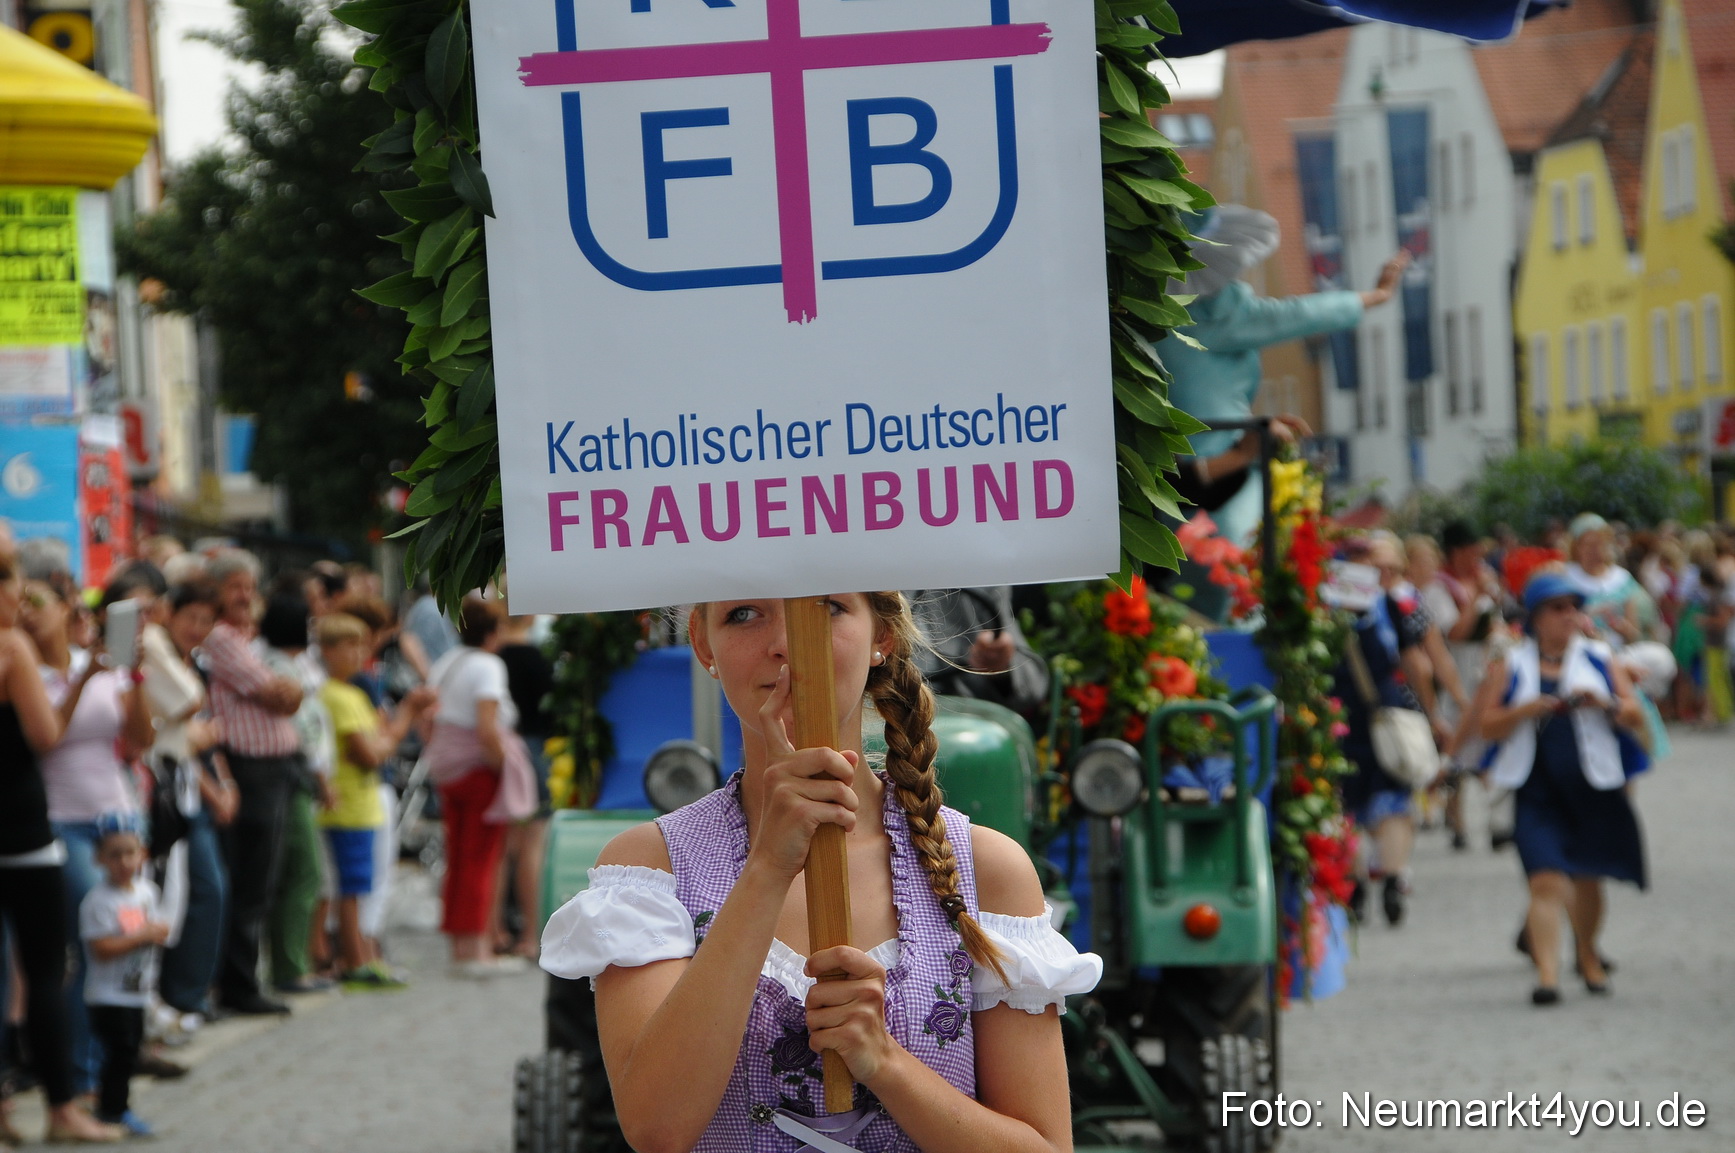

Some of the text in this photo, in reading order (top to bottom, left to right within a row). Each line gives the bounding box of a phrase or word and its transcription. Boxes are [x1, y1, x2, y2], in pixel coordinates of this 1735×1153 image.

[641, 97, 953, 240] F B
[547, 393, 1067, 474] Katholischer Deutscher
[548, 459, 1075, 552] FRAUENBUND
